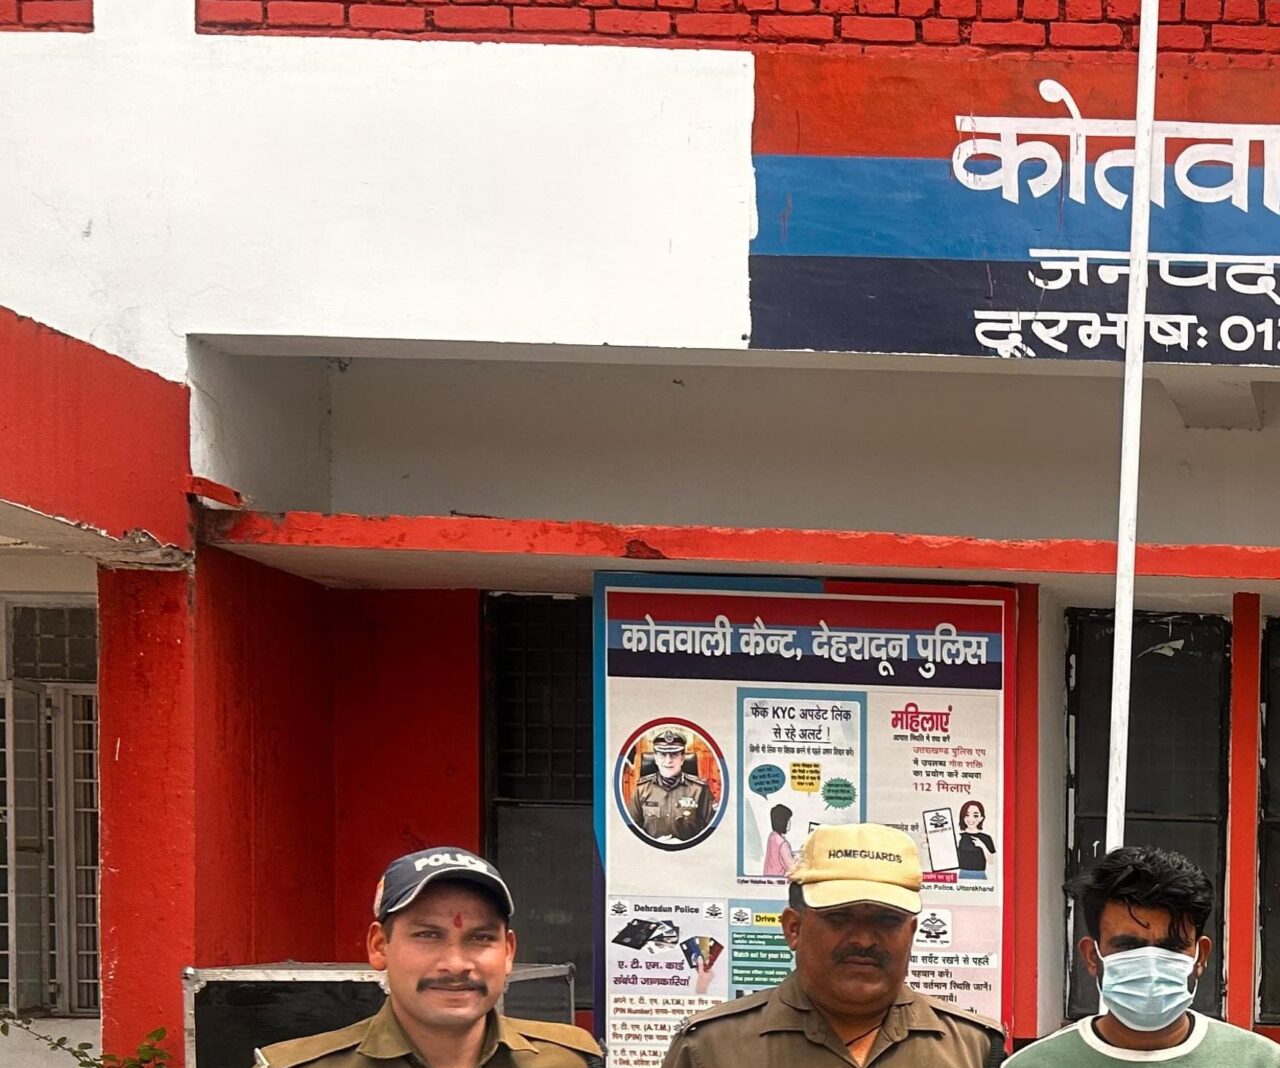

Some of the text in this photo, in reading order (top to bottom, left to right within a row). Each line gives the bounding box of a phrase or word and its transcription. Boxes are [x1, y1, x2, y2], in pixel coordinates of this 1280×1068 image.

[621, 614, 989, 679] कोतवाली कैन्ट, देहरादून पुलिस
[750, 702, 852, 721] फेक KYC अपडेट लिंक
[891, 702, 953, 732] महिलाएं
[772, 723, 782, 739] से
[798, 724, 822, 740] अलर्ट
[952, 746, 973, 757] पुलिस
[913, 782, 932, 792] 112
[414, 853, 488, 872] POLICE
[634, 904, 672, 912] Dehradun
[756, 914, 776, 922] Drive
[942, 954, 960, 964] रखने
[962, 954, 970, 964] से
